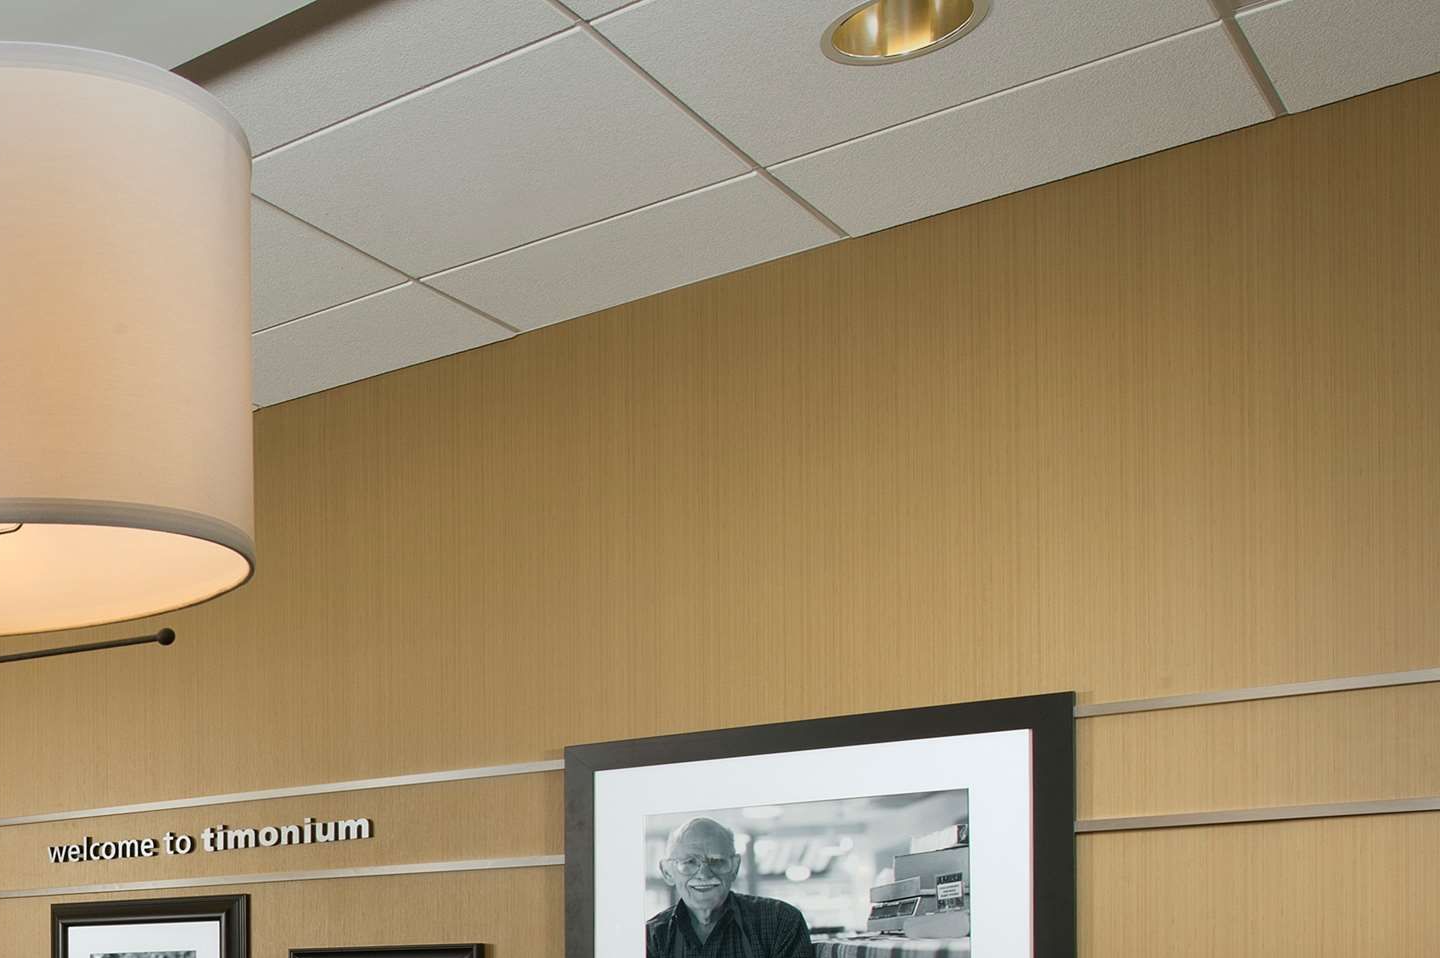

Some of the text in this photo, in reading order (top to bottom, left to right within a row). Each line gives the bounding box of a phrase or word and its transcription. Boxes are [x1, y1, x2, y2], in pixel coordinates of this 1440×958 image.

[48, 817, 371, 863] welcome to timonium
